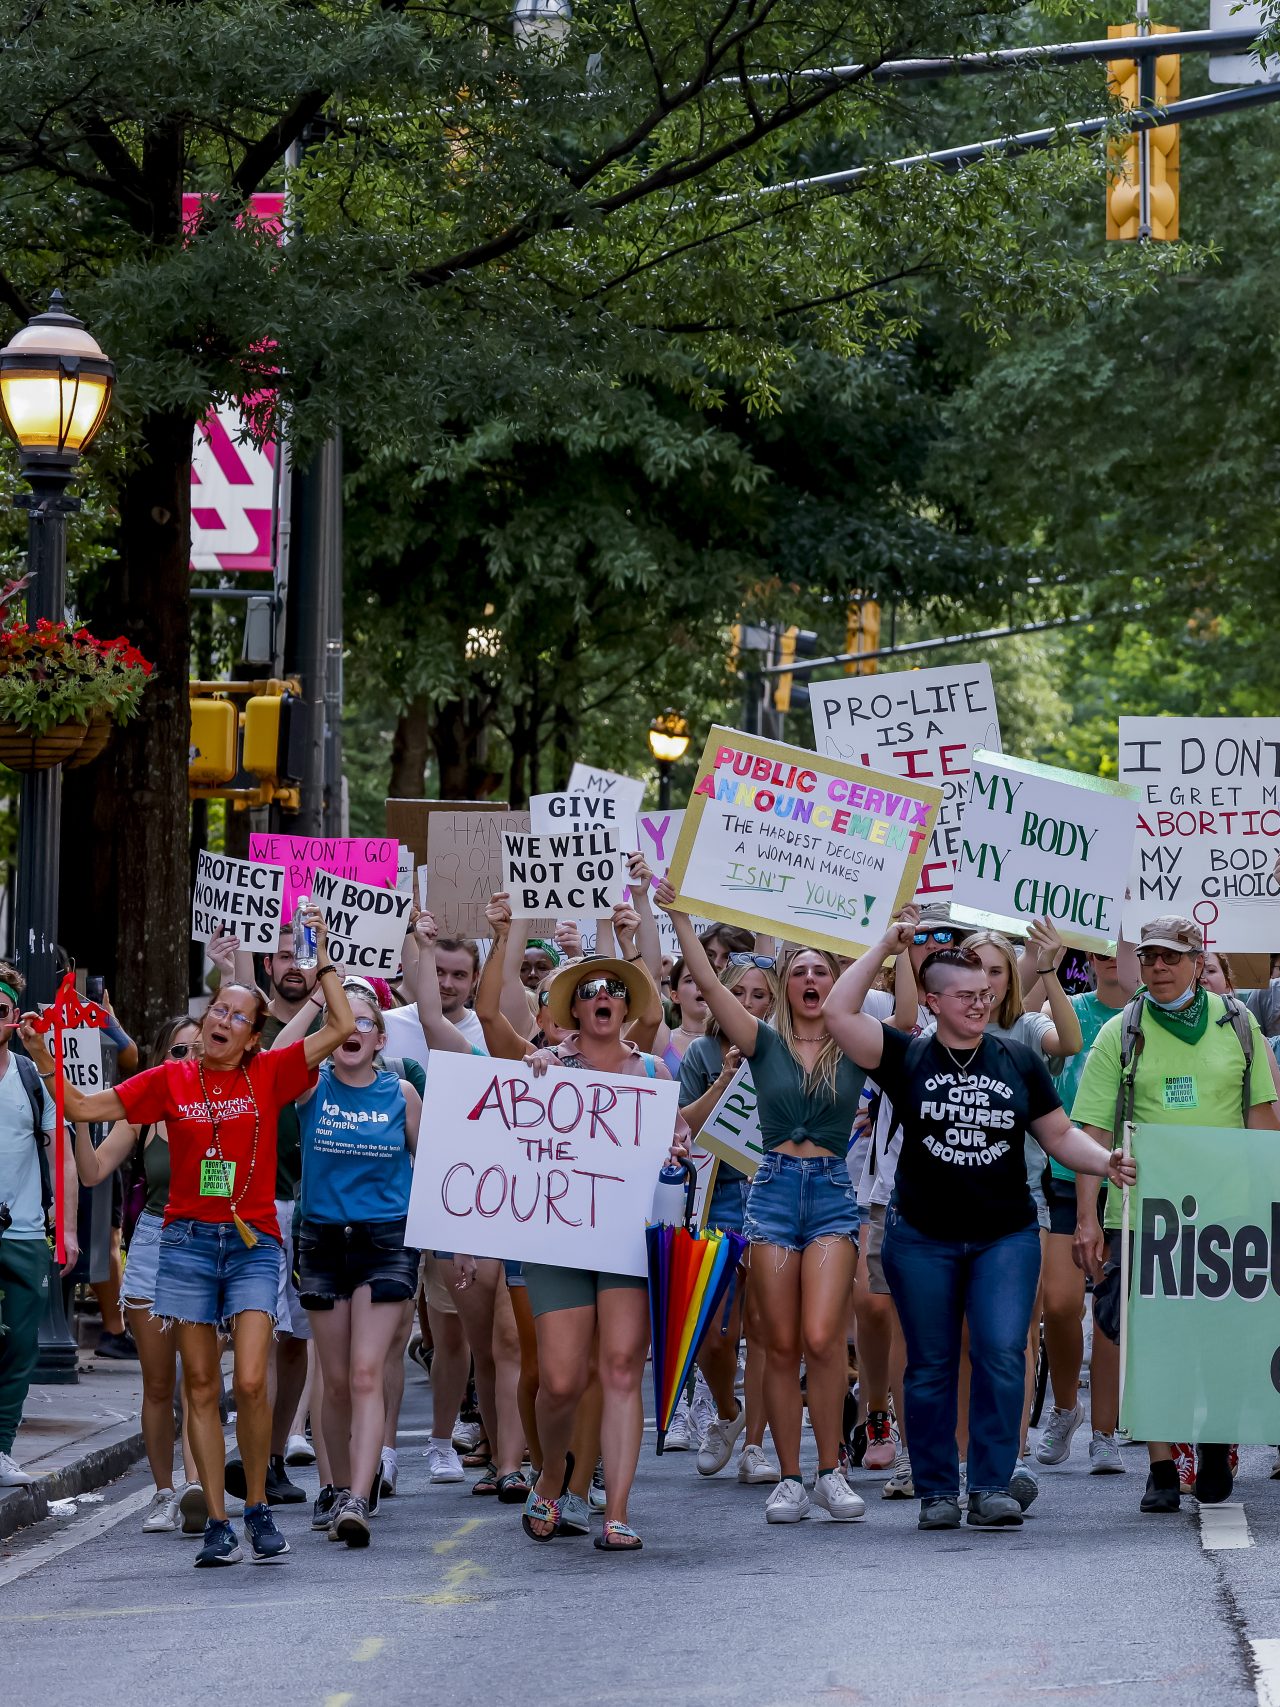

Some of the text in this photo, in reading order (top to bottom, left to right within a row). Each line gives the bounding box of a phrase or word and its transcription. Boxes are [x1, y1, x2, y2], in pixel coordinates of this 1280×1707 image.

[823, 680, 988, 730] PRO-LIFE
[876, 720, 944, 747] IS A
[1123, 741, 1163, 773] I
[586, 773, 618, 795] MY
[713, 745, 934, 828] PUBLIC CERVIX
[970, 770, 1024, 815] MY
[1146, 785, 1244, 807] EGRET
[548, 796, 616, 820] GIVE
[694, 773, 928, 856] ANNOUNCEMENT
[505, 831, 617, 859] WE WILL
[721, 813, 886, 872] THE HARDEST DECISION
[1020, 810, 1100, 862] BODY
[252, 839, 392, 863] WE WON'T GO
[734, 840, 861, 884] A WOMAN MAKES
[958, 839, 1012, 883] MY
[1141, 846, 1183, 875] MY
[198, 853, 284, 892] PROTECT
[509, 859, 614, 884] NOT GO
[725, 861, 796, 893] ISN'T
[195, 881, 281, 919] WOMENS
[312, 871, 412, 919] MY BODY
[522, 886, 611, 909] BACK
[1139, 875, 1183, 901] MY
[1013, 877, 1115, 933] CHOICE
[194, 910, 275, 944] RIGHTS
[325, 906, 359, 936] MY
[325, 938, 395, 969] OICE
[924, 1072, 957, 1091] OUR
[1165, 1076, 1193, 1085] ABORTION
[178, 1095, 254, 1112] MAKE AMERICA
[217, 1104, 248, 1117] AGAIN
[467, 1074, 658, 1148] ABORT
[948, 1086, 990, 1107] OUR
[920, 1101, 1015, 1130] FUTURES
[316, 1128, 333, 1136] noun
[945, 1128, 987, 1148] OUR
[322, 1147, 345, 1155] president
[516, 1136, 579, 1163] THE
[922, 1134, 1011, 1166] ABORTIONS
[205, 1161, 232, 1170] ABORTION
[441, 1162, 625, 1229] COURT
